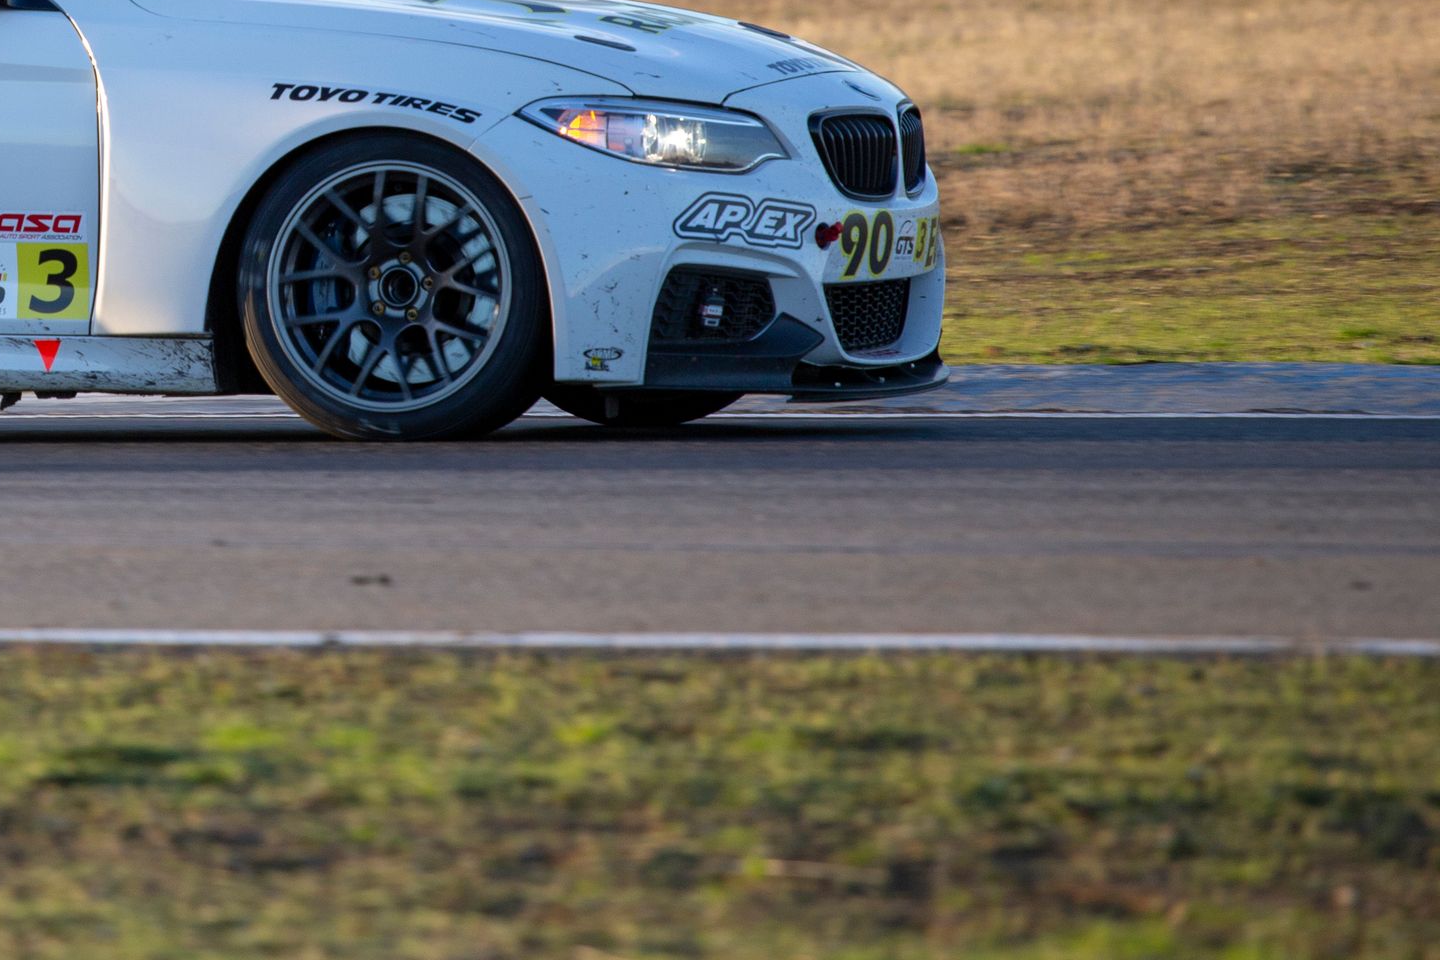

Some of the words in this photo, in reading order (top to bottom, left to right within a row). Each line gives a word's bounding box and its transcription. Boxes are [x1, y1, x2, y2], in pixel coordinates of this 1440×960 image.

[270, 82, 370, 103] TOYO
[371, 92, 482, 124] TIRES
[684, 200, 809, 241] APEX
[840, 207, 893, 280] 90
[895, 236, 915, 255] GTS
[914, 220, 927, 259] 3
[28, 248, 78, 314] 3
